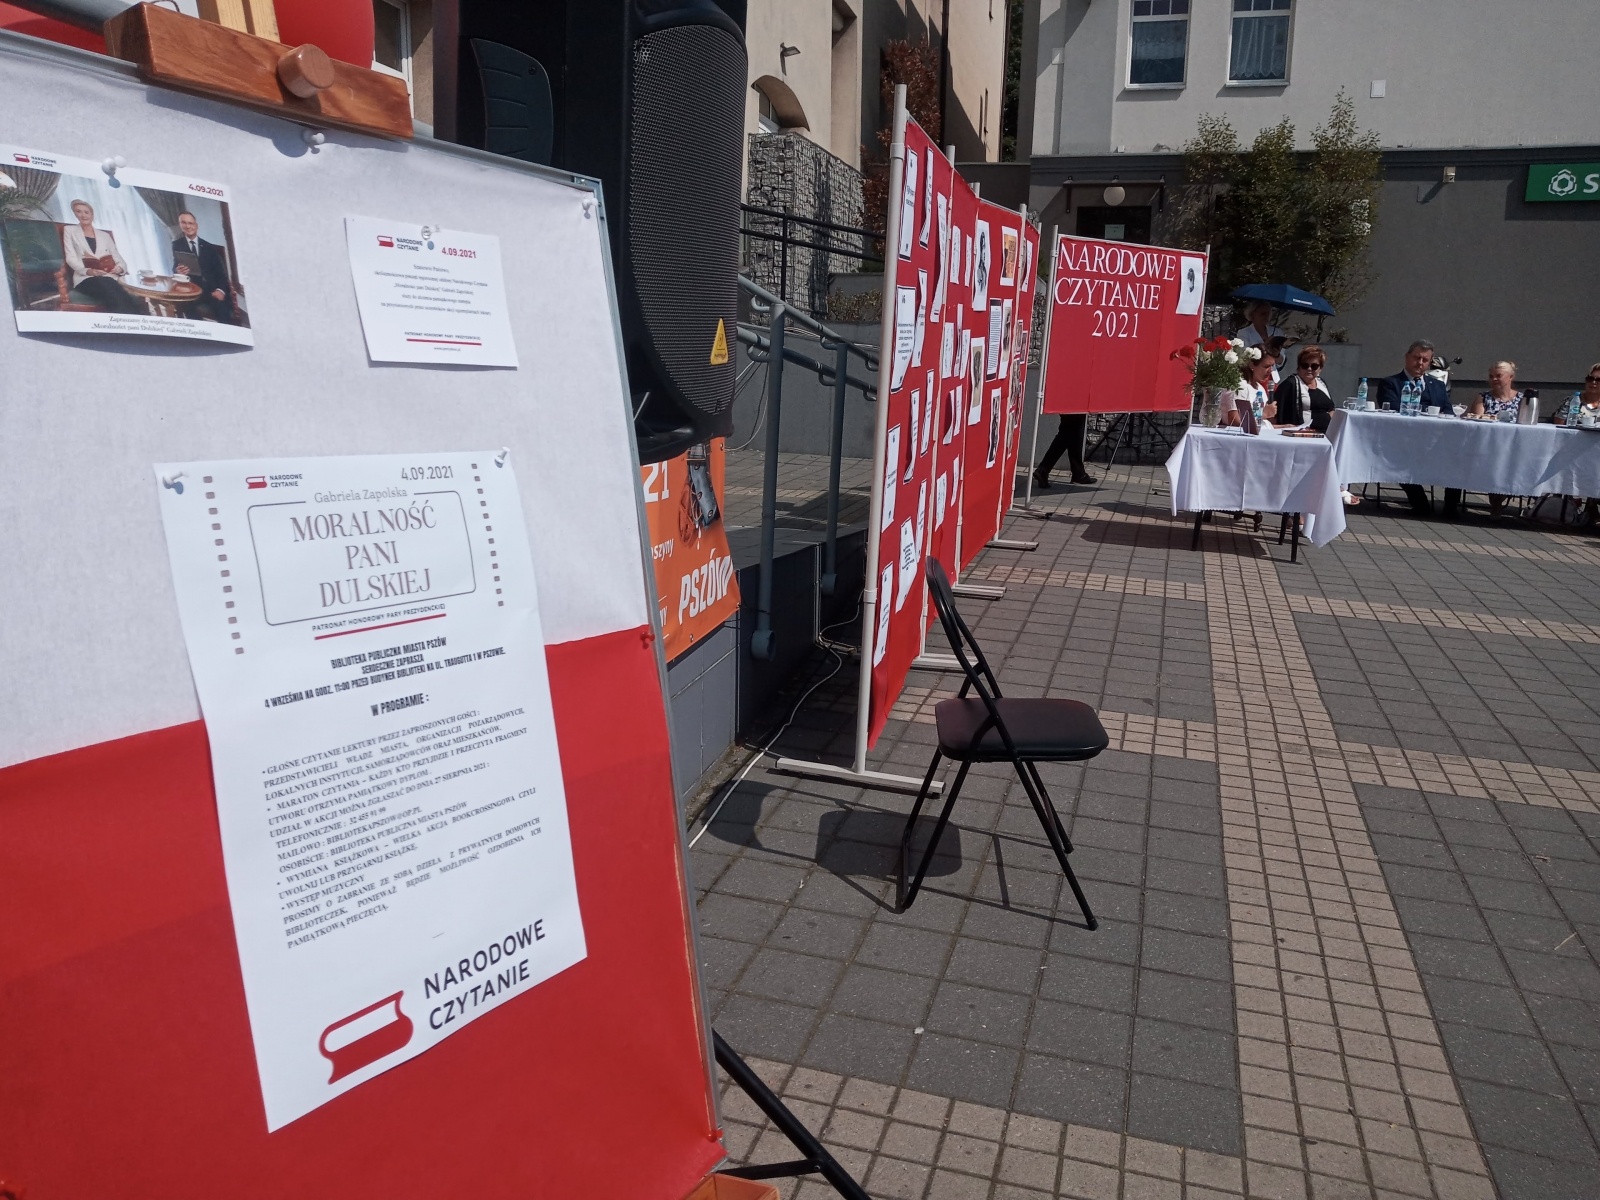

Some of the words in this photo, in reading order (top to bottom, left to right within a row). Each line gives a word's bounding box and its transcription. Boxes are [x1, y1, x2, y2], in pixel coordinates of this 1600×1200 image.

[188, 183, 224, 197] 4.09.2021
[442, 247, 476, 258] 4.09.2021
[1058, 243, 1177, 281] NARODOWE
[1054, 277, 1160, 310] CZYTANIE
[1092, 310, 1139, 338] 2021
[401, 466, 454, 481] 4.09.2021
[314, 490, 361, 503] Gabriela
[362, 487, 408, 502] Zapolska
[290, 501, 437, 542] MORALNOŚĆ
[345, 541, 400, 569] PANI
[651, 539, 674, 561] szyny
[319, 568, 431, 608] DULSKIEJ
[678, 547, 733, 625] PSZÓW
[312, 621, 346, 631] PATRONAT
[348, 614, 384, 624] HONOROWY
[331, 654, 366, 668] BIBLIOTEKA
[368, 646, 402, 661] PUBLICZNA
[403, 642, 426, 654] MIASTA
[427, 636, 446, 649] PSZÓW
[362, 660, 395, 674] SERDECZNIE
[396, 654, 424, 667] ZAPRASZA
[265, 699, 270, 708] 4
[270, 692, 304, 707] WRZEŚNIA
[305, 690, 314, 699] NA
[315, 685, 333, 696] GODZ.
[335, 682, 350, 692] 11:00
[352, 677, 369, 688] PRZED
[370, 671, 395, 684] BUDYNEK
[397, 665, 425, 678] BIBLIOTEKI
[427, 663, 435, 672] NA
[444, 654, 472, 667] TRAUGUTTA
[371, 705, 378, 716] W
[380, 693, 424, 714] PROGRAMIE
[264, 761, 338, 788] PRZEDSTAWICIELI
[346, 751, 373, 763] WŁADZ
[416, 726, 462, 743] ORGANIZACJI
[302, 747, 341, 764] CZYTANIE
[342, 739, 376, 753] LEKTURY
[378, 731, 400, 743] PRZEZ
[402, 716, 456, 736] ZAPROSZONYCH
[265, 780, 318, 801] LOKALNYCH
[365, 745, 431, 770] SAMORZĄDOWCÓW
[433, 739, 451, 750] ORAZ
[277, 792, 319, 810] MARATON
[322, 780, 360, 796] CZYTANIA
[369, 769, 393, 781] KAŻDY
[396, 764, 411, 773] KTO
[413, 752, 448, 768] PRZYJDZIE
[456, 739, 493, 754] PRZECZYTA
[495, 728, 527, 742] FRAGMENT
[269, 808, 306, 825] UTWORU
[308, 796, 347, 813] OTRZYMA
[348, 779, 398, 800] PAMIĄTKOWY
[270, 823, 302, 837] UDZIAŁ
[314, 811, 337, 824] AKCJI
[339, 802, 366, 817] MOŻNA
[368, 787, 404, 806] ZGŁASZAĆ
[406, 785, 415, 793] DO
[417, 780, 433, 790] DNIA
[442, 767, 472, 781] SIERPNIA
[474, 763, 486, 771] 2021
[276, 822, 342, 848] TELEFONICZNIE
[278, 842, 320, 860] MAILOWO
[280, 852, 325, 873] OSOBIŚCIE
[330, 835, 376, 855] BIBLIOTEKA
[377, 820, 417, 839] PUBLICZNA
[417, 811, 443, 824] MIASTA
[445, 801, 467, 814] PSZÓW
[287, 865, 328, 882] WYMIANA
[334, 846, 379, 867] KSIĄŻKOWA
[393, 831, 421, 844] WIELKA
[427, 821, 448, 832] AKCJA
[519, 787, 536, 798] CZYLI
[279, 880, 318, 899] UWOLNIJ
[320, 874, 335, 885] LUB
[337, 855, 383, 878] PRZYGARNIJ
[283, 904, 320, 924] PROSIMY
[338, 883, 376, 903] ZABRANIE
[381, 877, 390, 886] ZE
[417, 858, 442, 871] DZIEŁA
[458, 833, 502, 855] PRYWATNYCH
[505, 817, 540, 836] DOMOWYCH
[357, 886, 397, 907] PONIEWAŻ
[406, 873, 431, 887] BĘDZIE
[439, 852, 479, 873] MOŻLIWOŚĆ
[488, 836, 524, 854] OZDOBIENIA
[531, 828, 541, 836] ICH
[286, 892, 320, 909] WYSTĘP
[322, 875, 365, 896] MUZYCZNY
[288, 922, 345, 948] PAMIĄTKOWĄ
[424, 919, 546, 999] NARODOWE
[429, 959, 530, 1030] CZYTANIE
